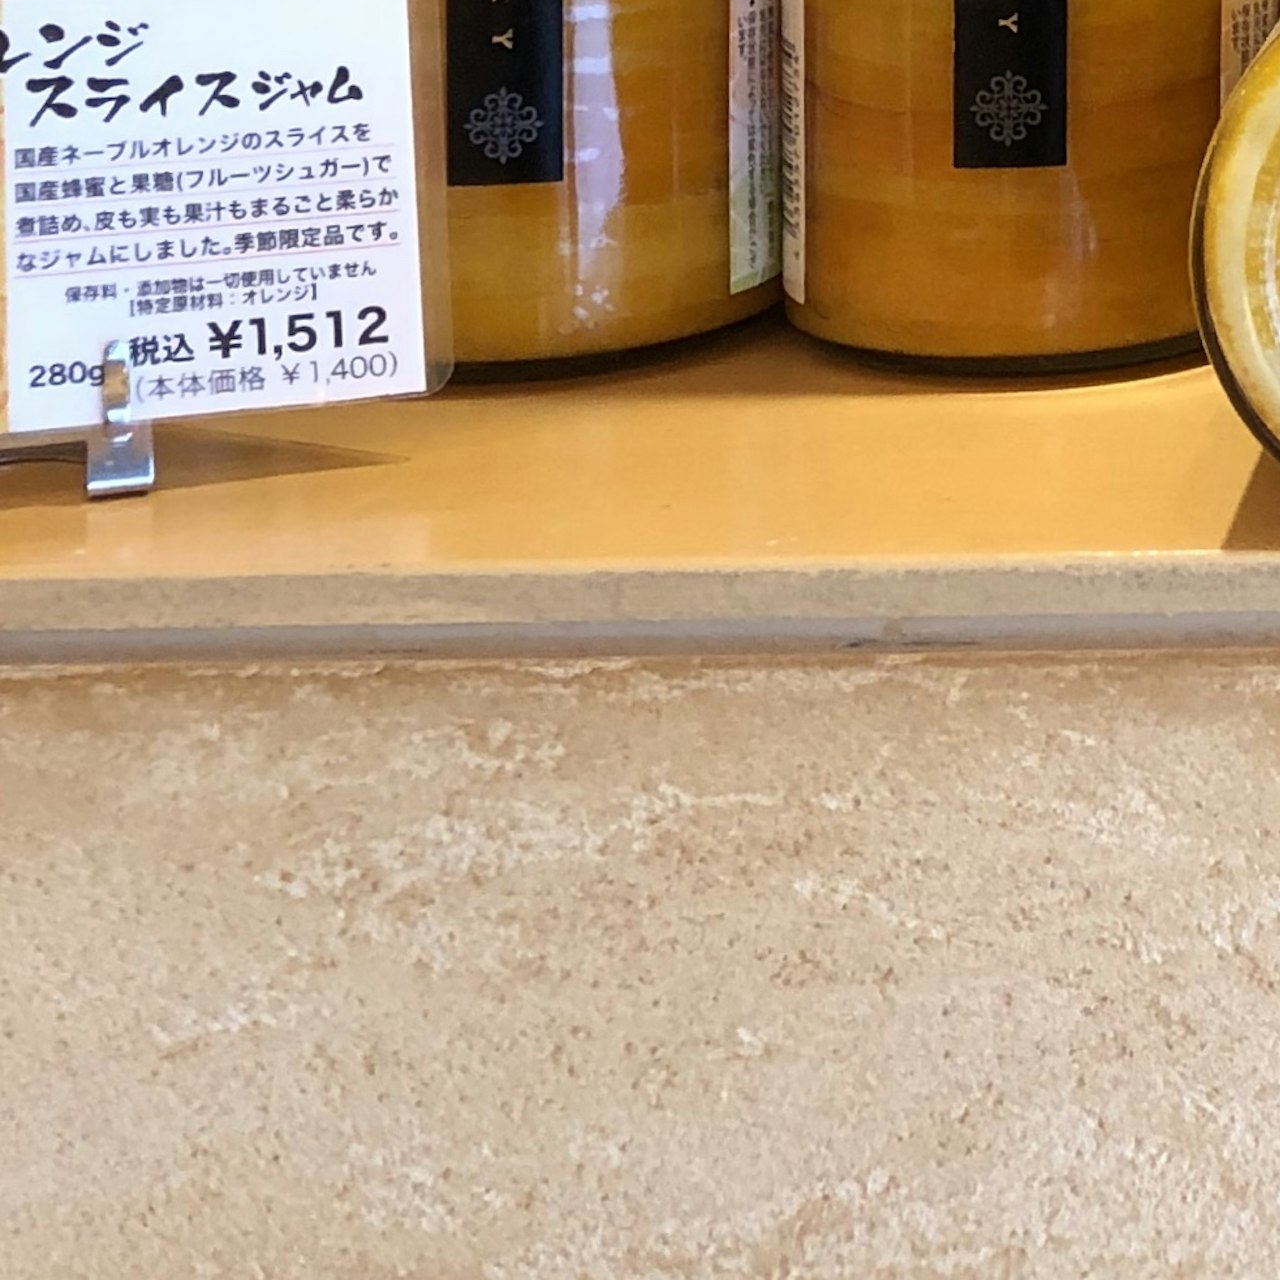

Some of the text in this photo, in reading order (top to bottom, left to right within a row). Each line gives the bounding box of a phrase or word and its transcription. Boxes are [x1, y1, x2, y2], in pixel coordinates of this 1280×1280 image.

[25, 66, 364, 127] スライスジャム
[14, 122, 371, 170] 国産ネーブルオレンジのスライスを
[16, 187, 399, 238] 煮詰め、皮も実も果汁もまるごと柔らか
[16, 220, 400, 272] なジャムにしました。季節限定品です。
[130, 305, 390, 367] 税込 ¥1,512
[29, 361, 106, 389] 280g
[135, 368, 266, 403] (本体価格
